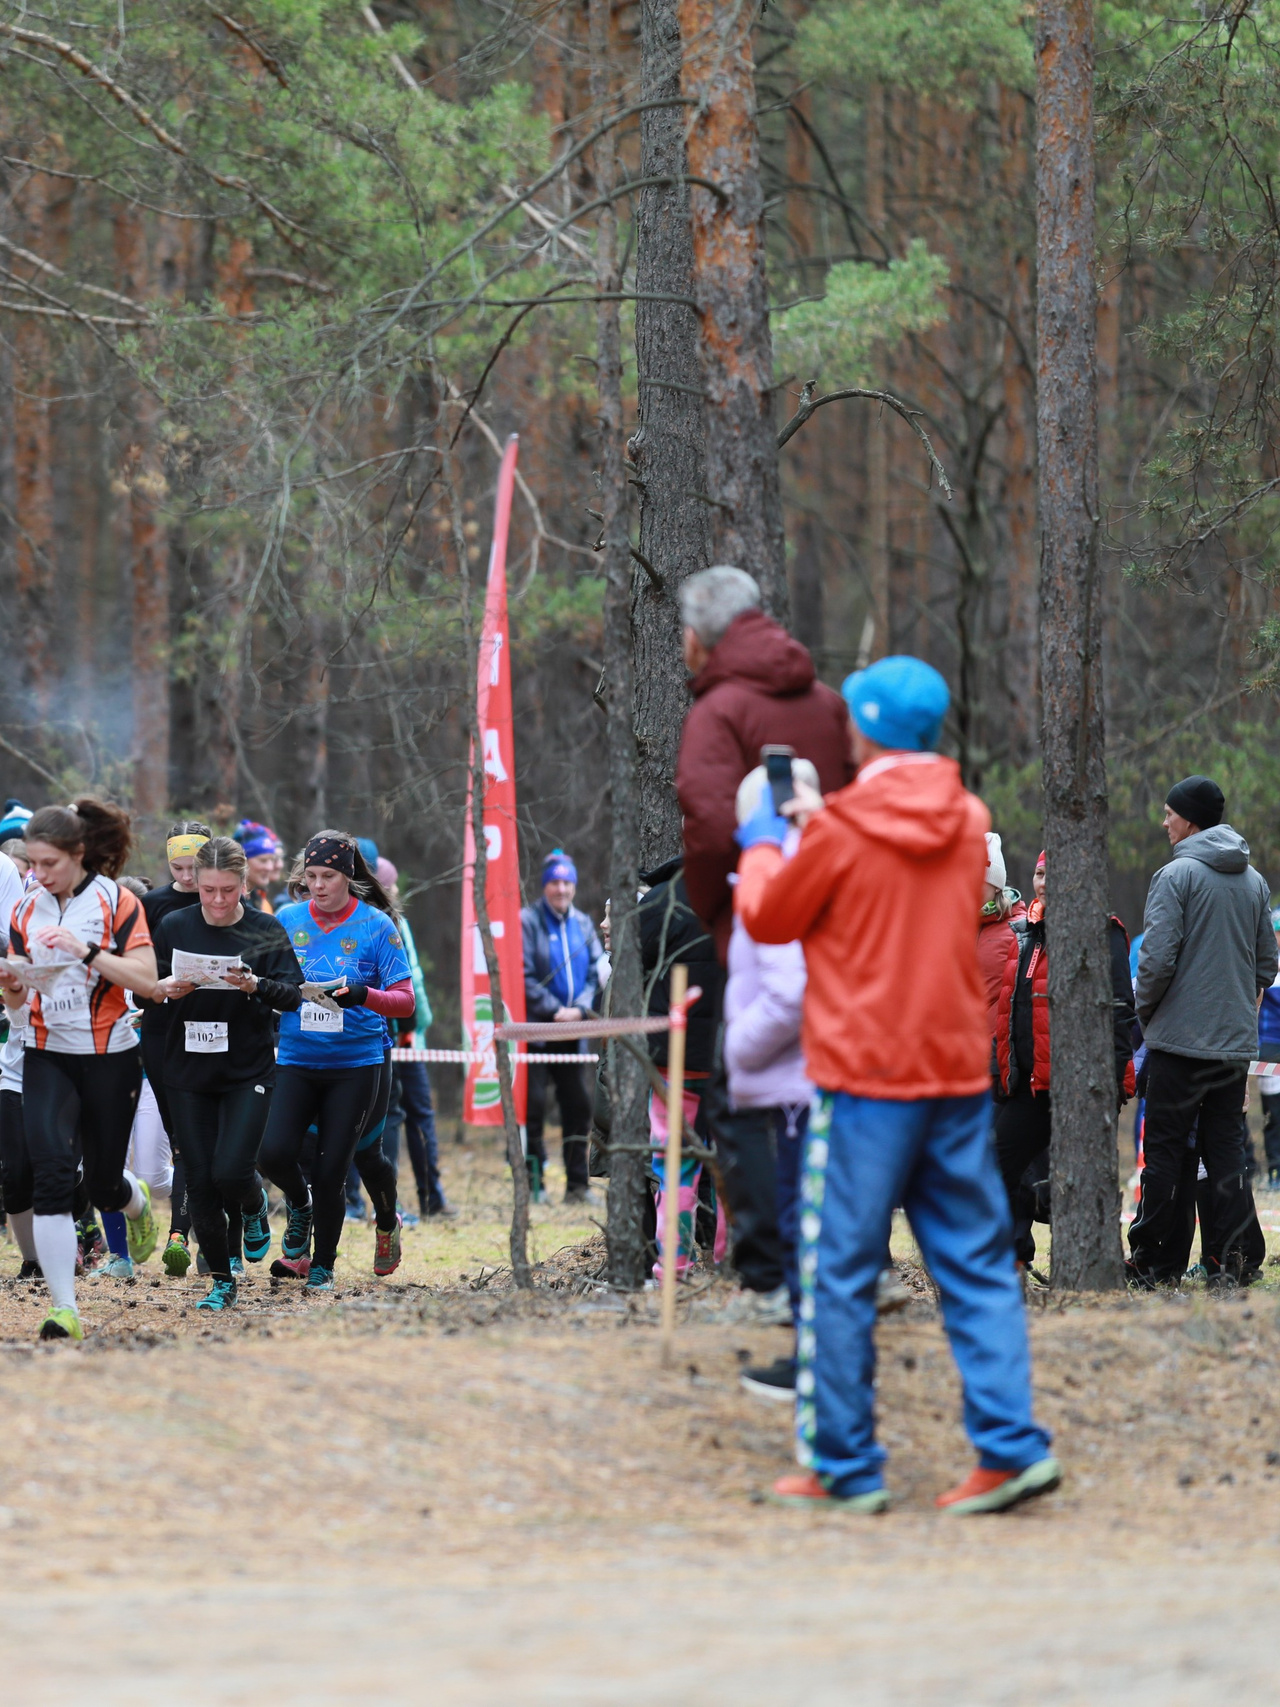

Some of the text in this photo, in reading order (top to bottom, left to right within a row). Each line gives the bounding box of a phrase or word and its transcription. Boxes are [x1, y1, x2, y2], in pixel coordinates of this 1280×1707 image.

[54, 999, 71, 1012] 101
[313, 1012, 331, 1022] 107
[197, 1032, 215, 1043] 102
